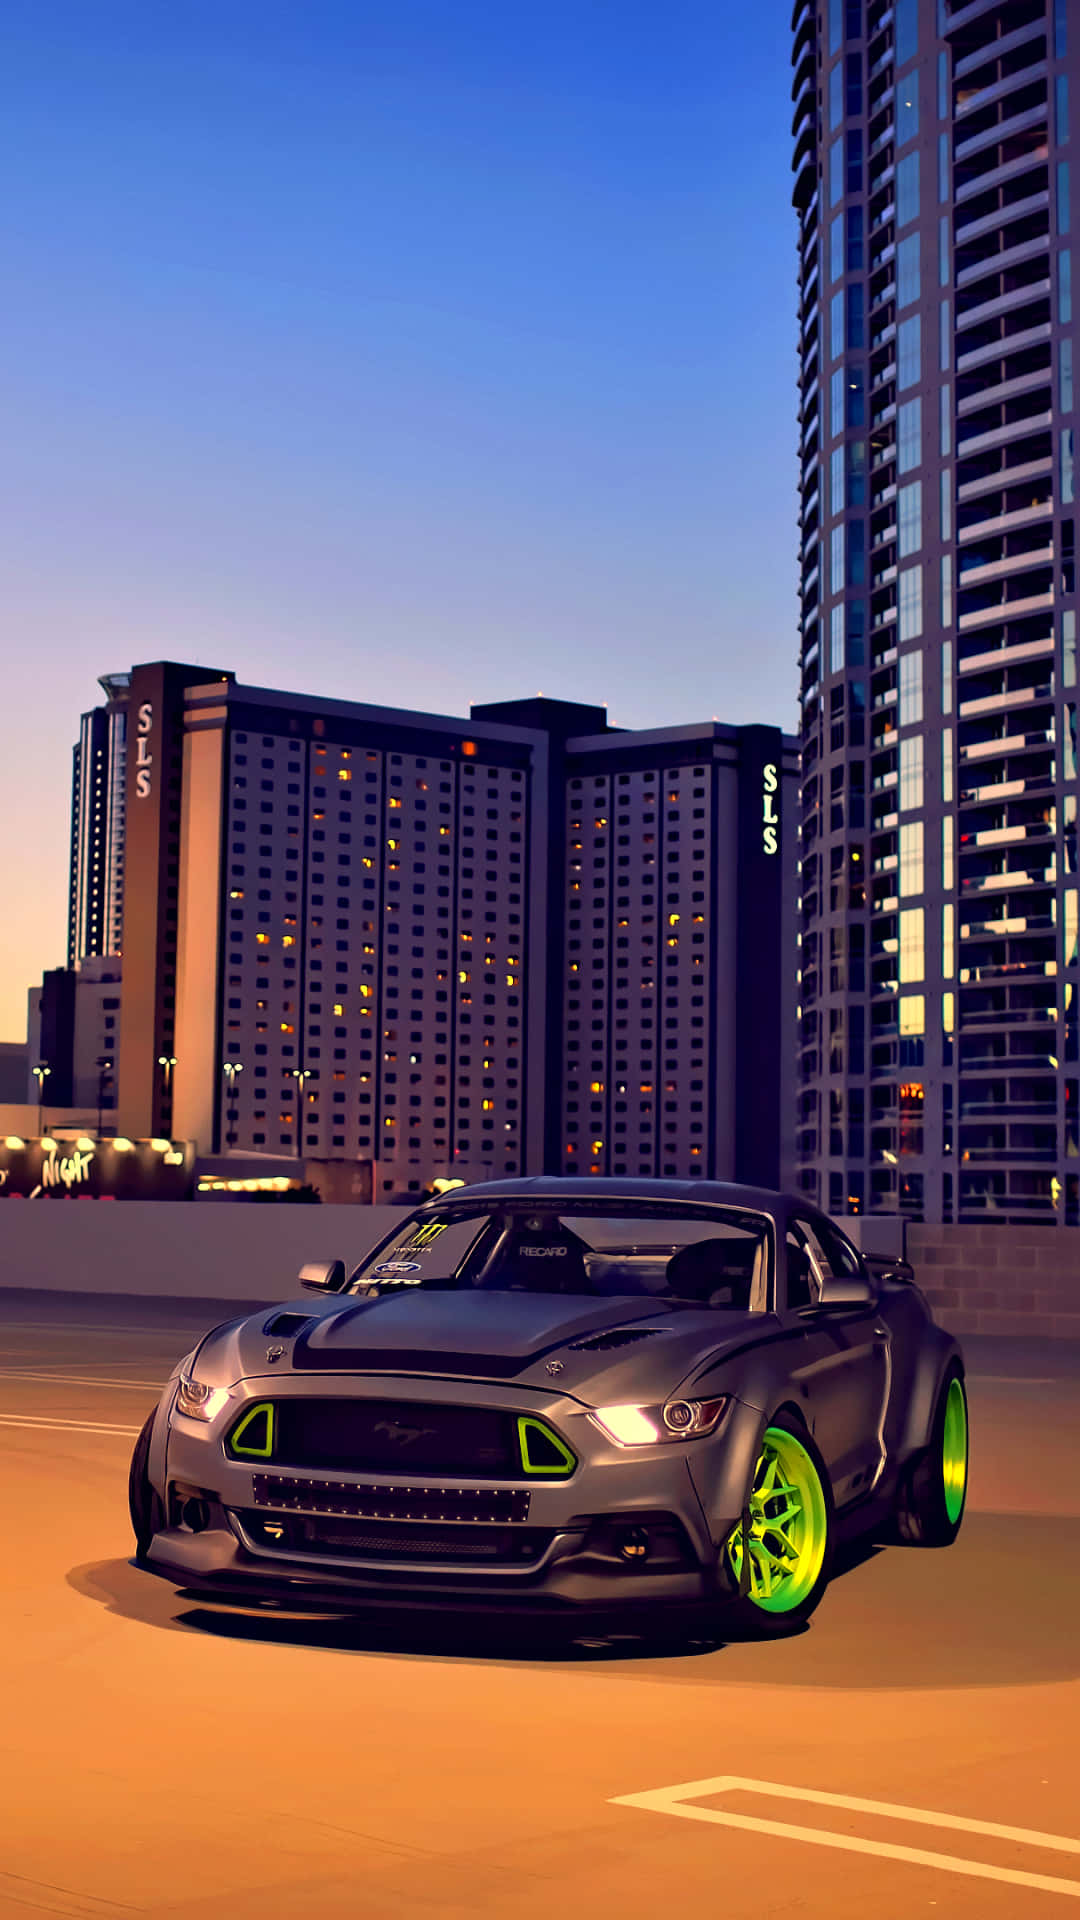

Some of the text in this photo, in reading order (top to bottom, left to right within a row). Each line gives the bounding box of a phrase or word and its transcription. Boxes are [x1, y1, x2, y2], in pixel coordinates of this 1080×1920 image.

[136, 704, 152, 798] SLS
[763, 764, 778, 854] SLS
[519, 1246, 568, 1257] RECARO
